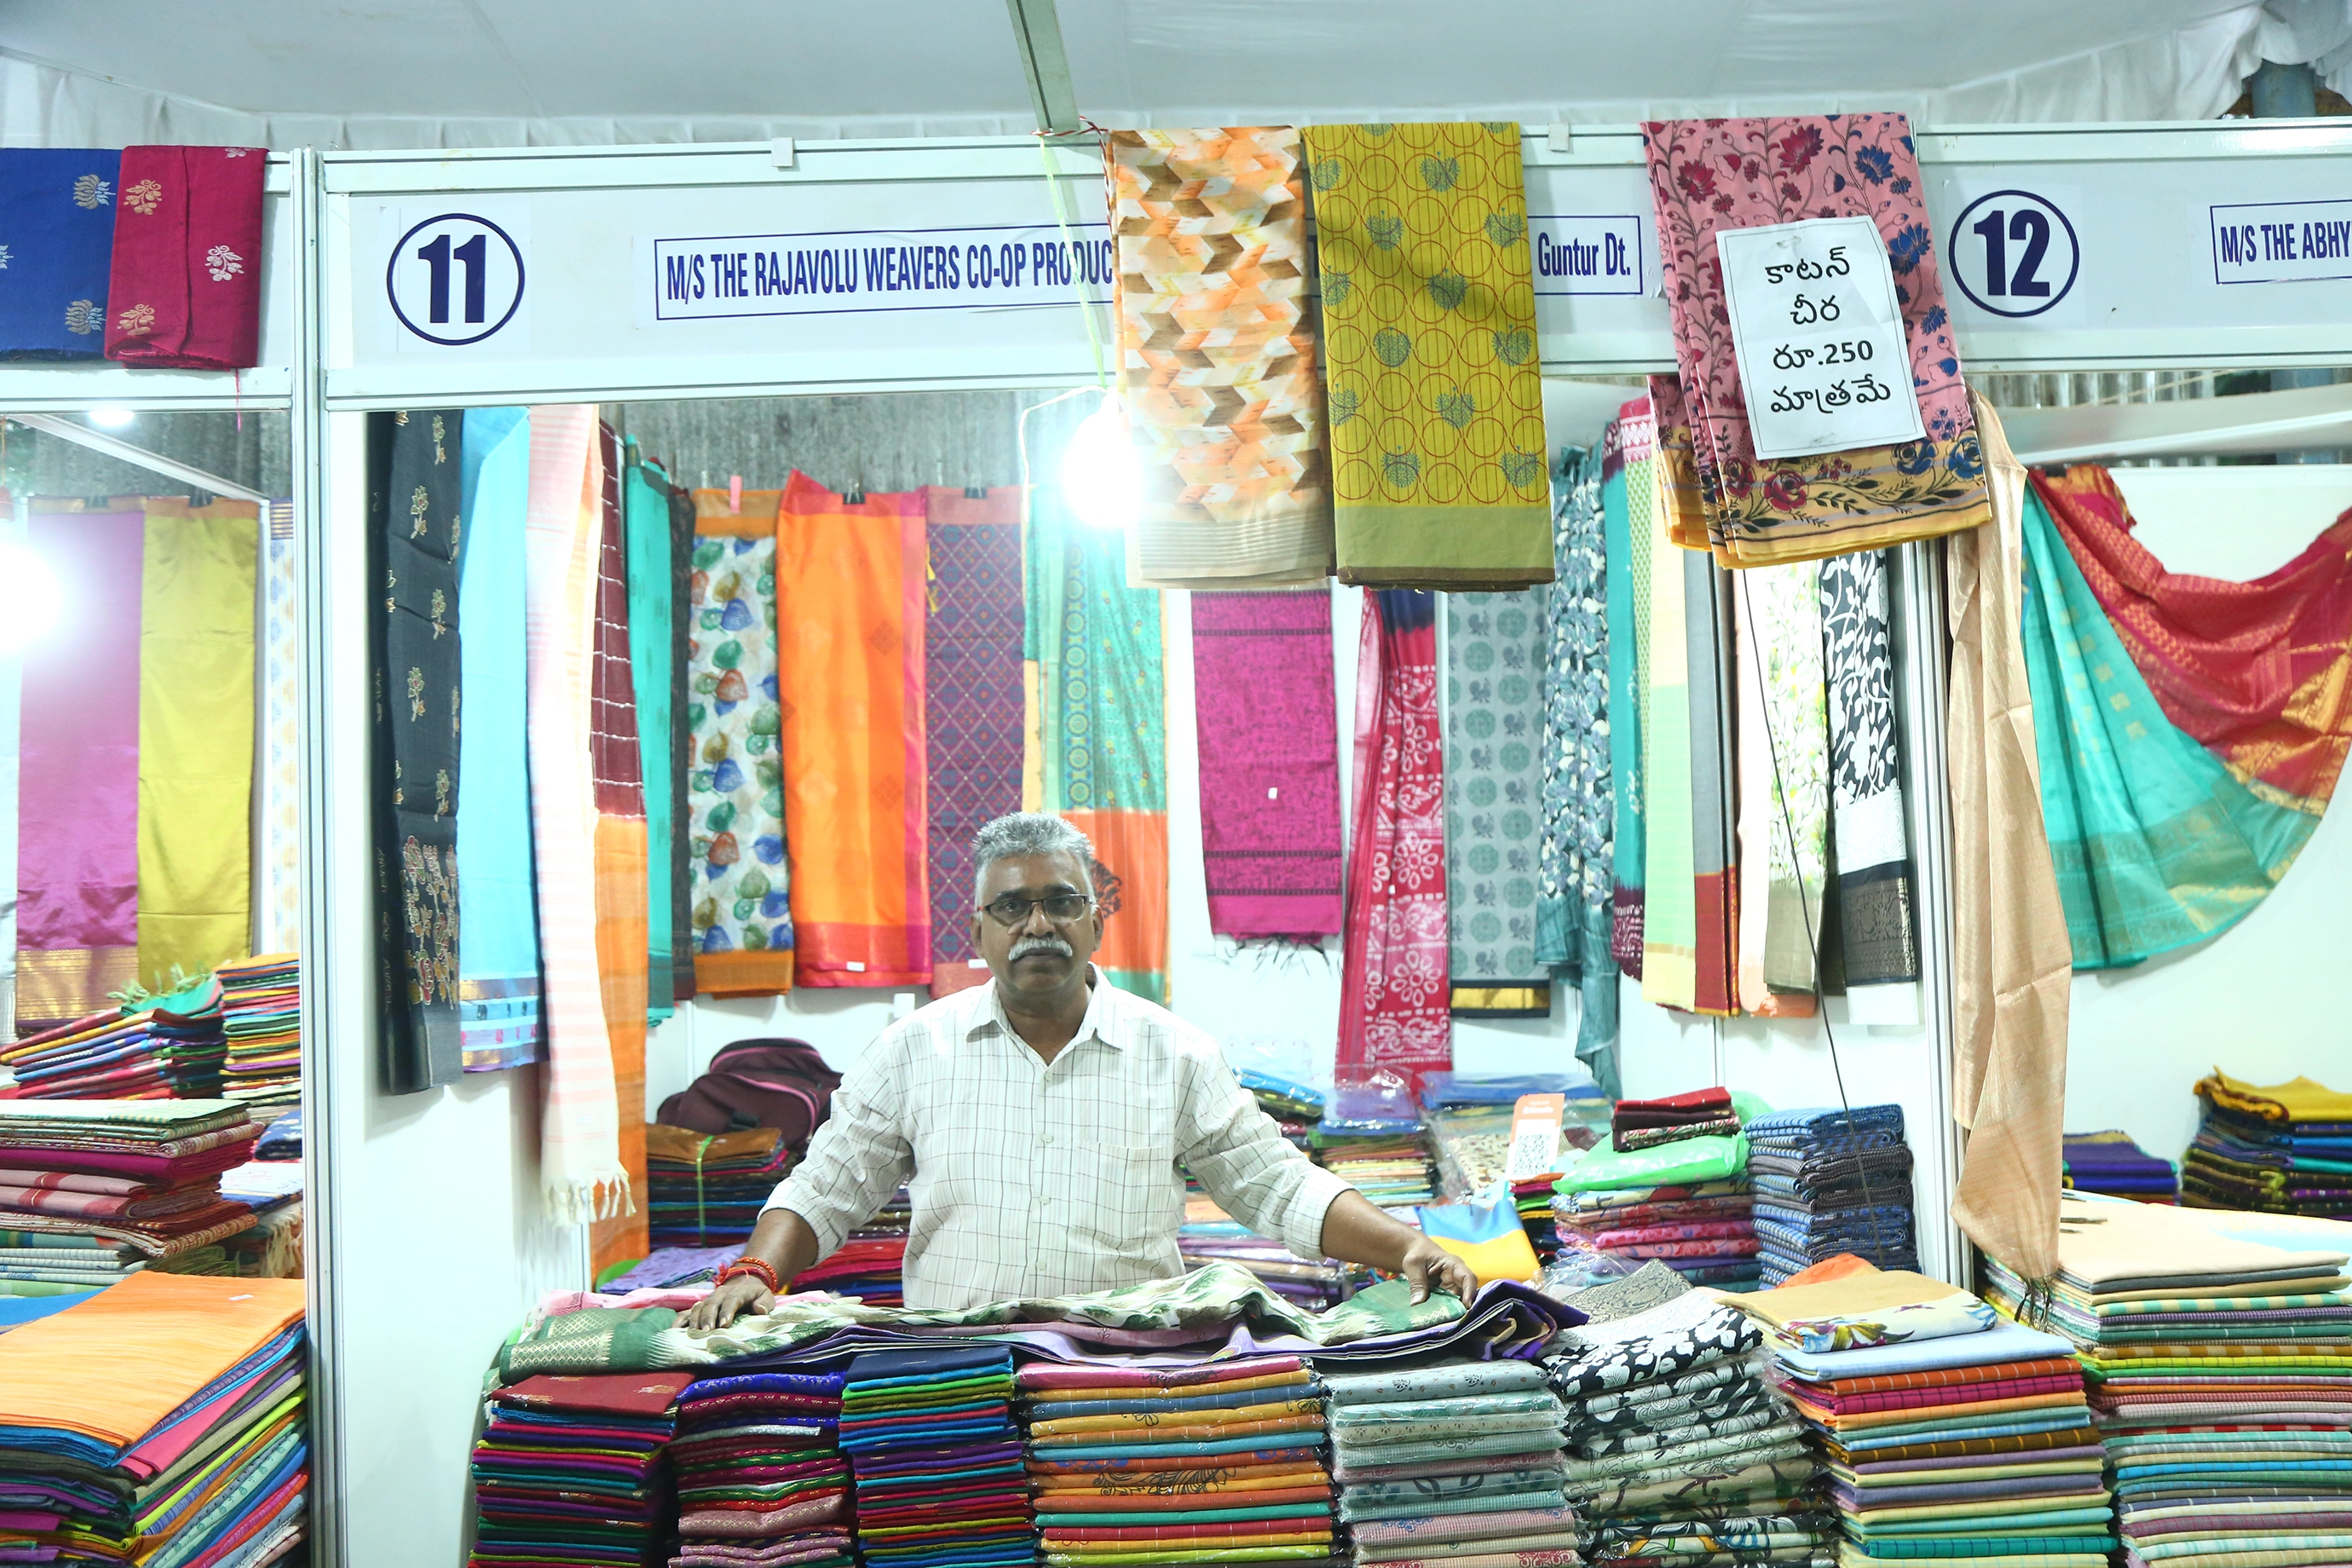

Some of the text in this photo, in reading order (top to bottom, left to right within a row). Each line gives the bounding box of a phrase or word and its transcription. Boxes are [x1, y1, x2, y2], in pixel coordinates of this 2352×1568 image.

[1764, 246, 1850, 284] కాటన్
[1974, 210, 2050, 297] 12
[2220, 225, 2257, 266] M/S
[2260, 223, 2297, 261] THE
[418, 234, 486, 324] 11
[666, 254, 705, 304] M/S
[711, 253, 748, 297] THE
[755, 249, 857, 296] RAJAVOLU
[863, 245, 960, 291] WEAVERS
[967, 244, 1026, 288] CO-OP
[1537, 232, 1599, 277] Guntur
[1605, 233, 1631, 276] Dt.
[1790, 294, 1841, 325] చీర
[1770, 373, 1891, 414] మాత్రమే
